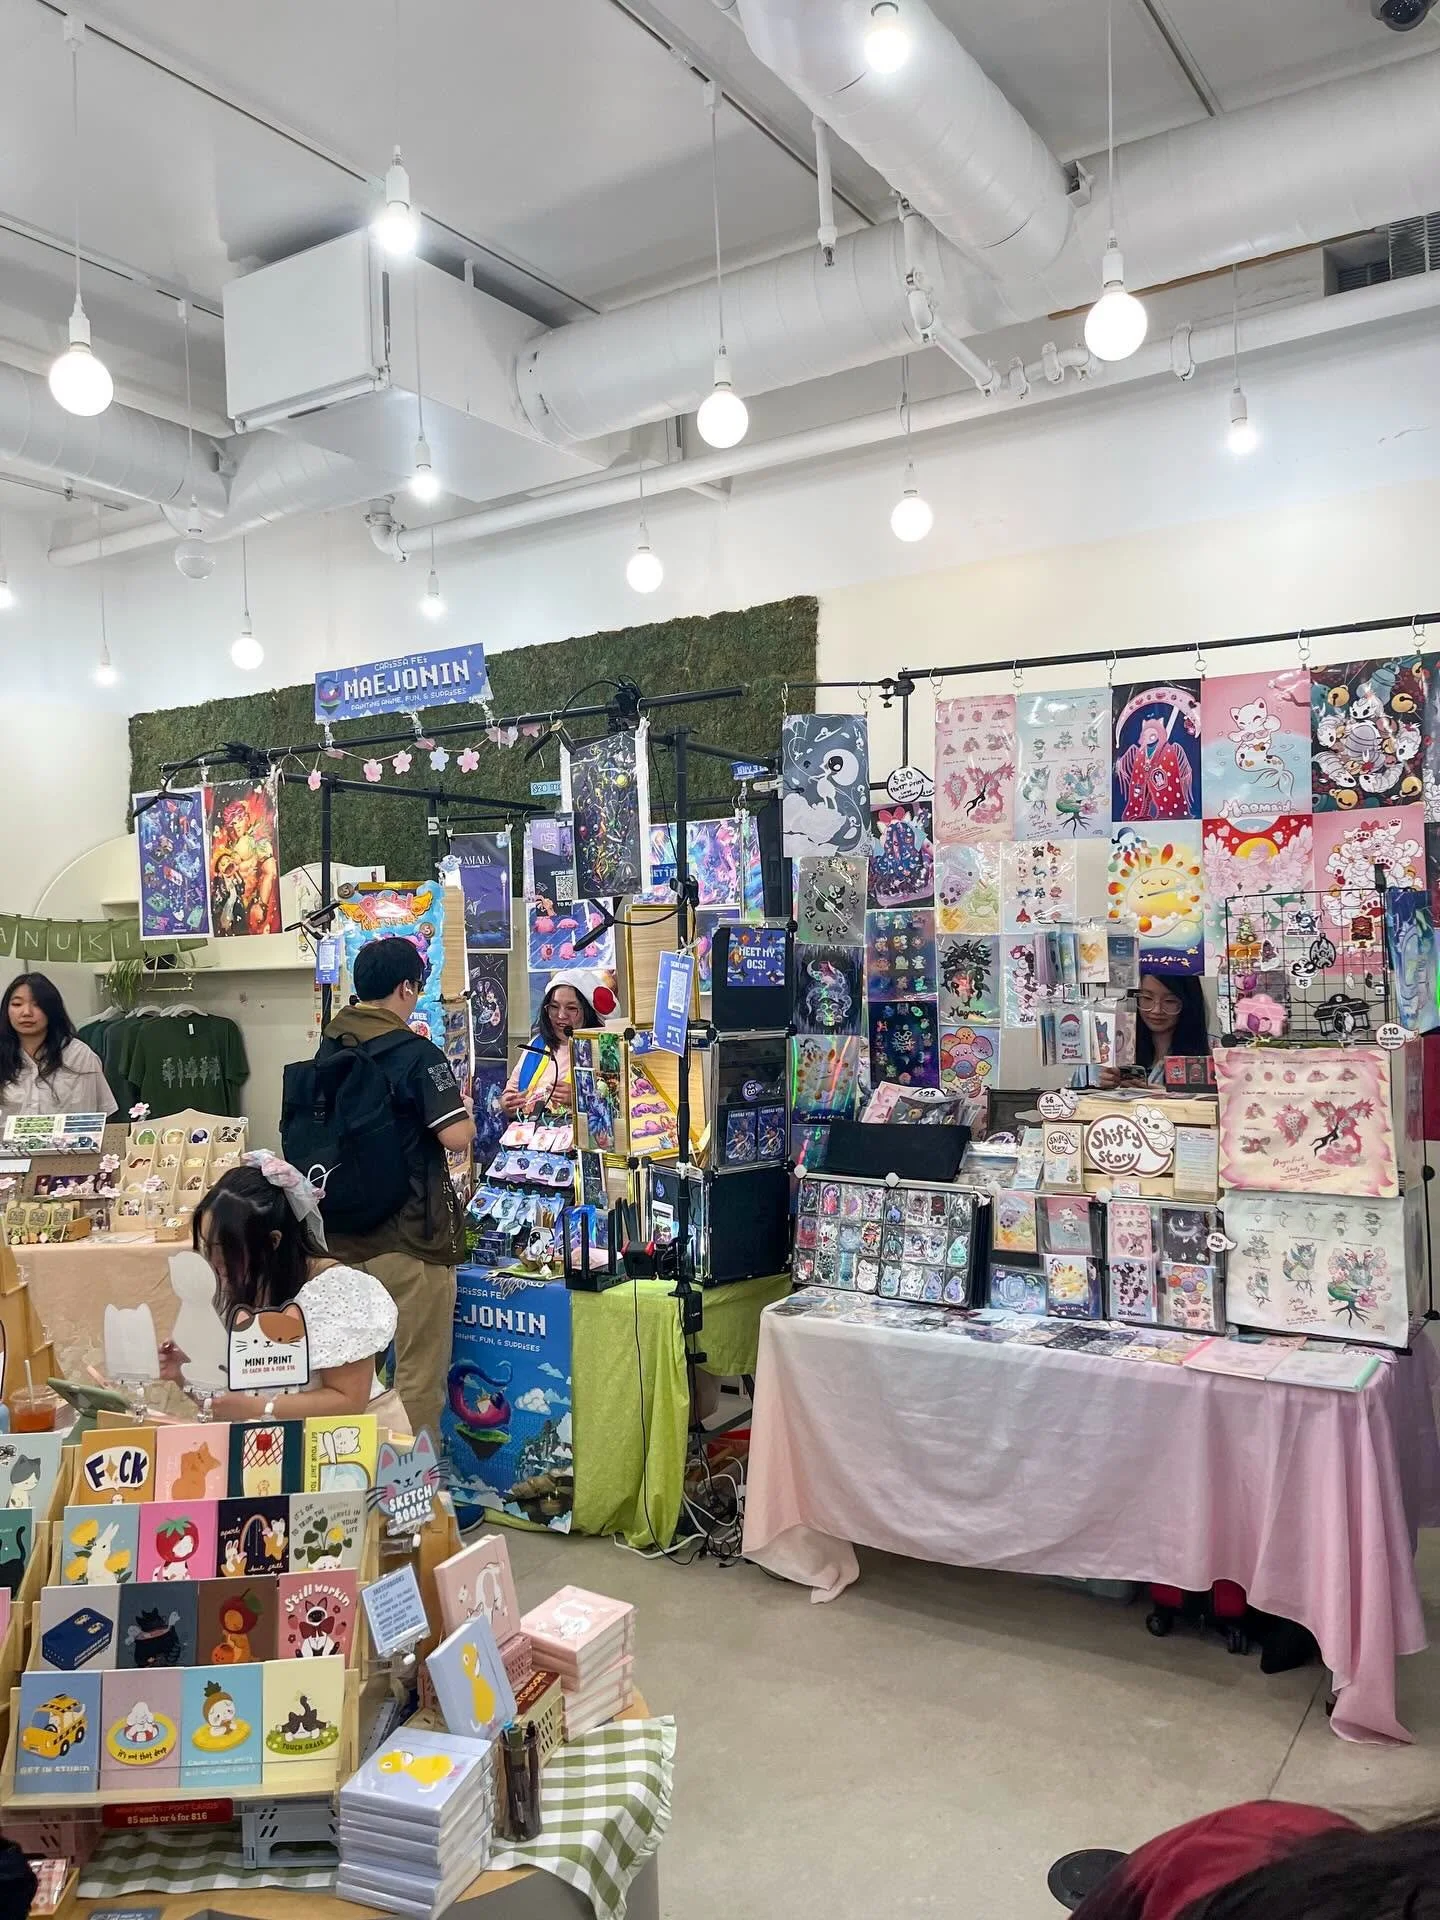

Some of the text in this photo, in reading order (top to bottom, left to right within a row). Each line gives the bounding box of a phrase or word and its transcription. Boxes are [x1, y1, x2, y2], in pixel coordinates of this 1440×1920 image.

[343, 660, 470, 701] MAEJONIN
[762, 947, 775, 958] MY
[747, 959, 766, 970] OCS!
[1383, 1027, 1399, 1036] $10
[1091, 1124, 1143, 1149] Shifty
[245, 1354, 293, 1367] MINI PRINT
[389, 1484, 433, 1513] SKETCH
[394, 1499, 432, 1524] BOOKS
[342, 1517, 358, 1526] YOUR
[284, 1583, 351, 1613] Still workin
[282, 1743, 303, 1751] TOUCH
[139, 1751, 152, 1761] that
[139, 1814, 159, 1824] each
[177, 1812, 190, 1821] for
